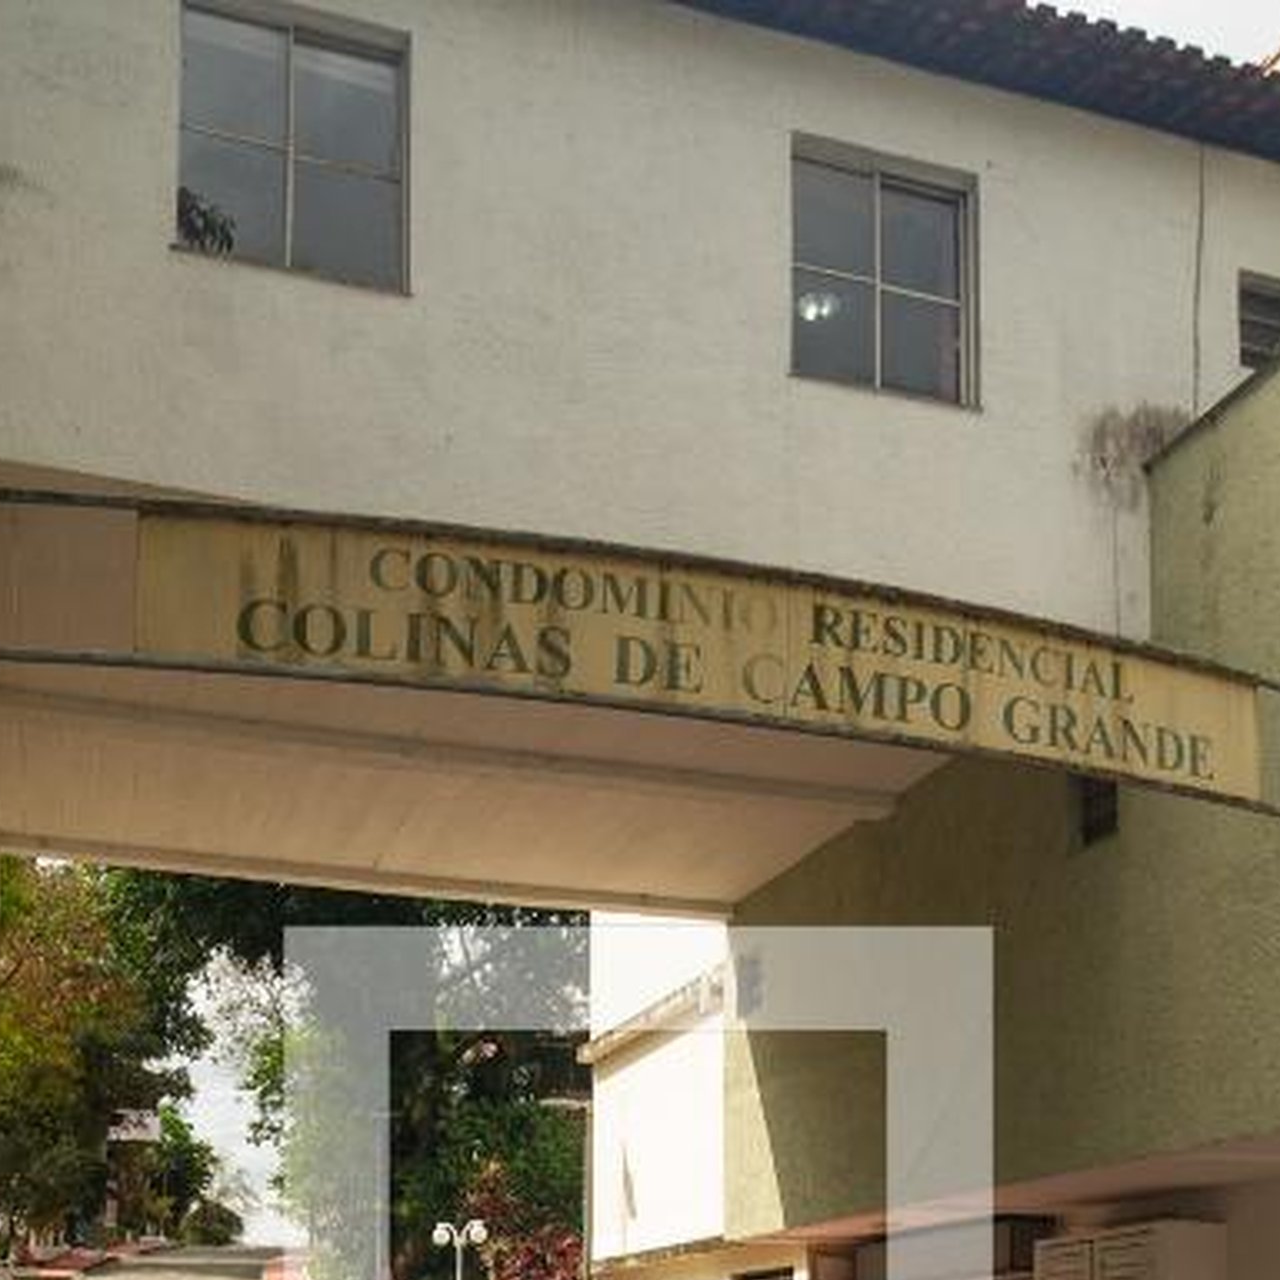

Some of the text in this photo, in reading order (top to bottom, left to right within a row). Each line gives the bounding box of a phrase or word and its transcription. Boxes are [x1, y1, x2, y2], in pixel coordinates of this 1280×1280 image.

[236, 599, 1215, 781] COLINAS DE CAMPO GRANDE
[810, 603, 1134, 702] RESIDENCIAL
